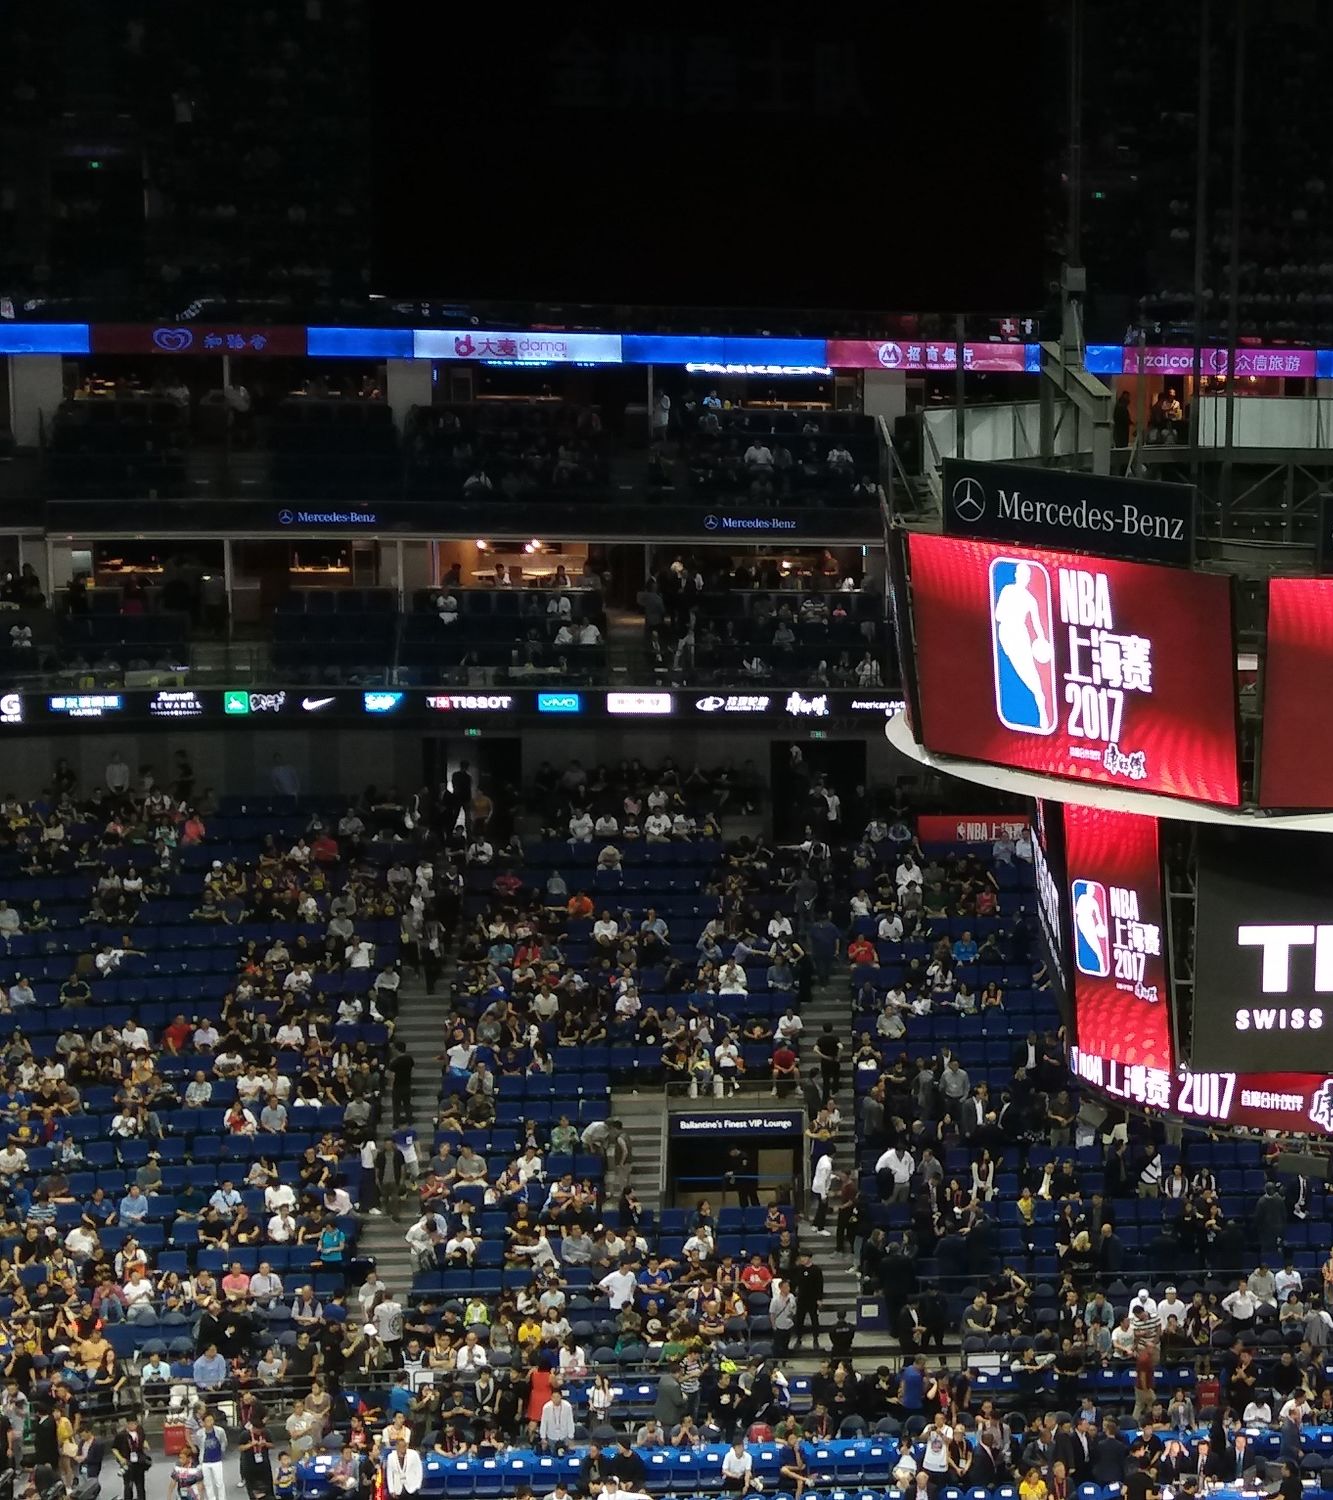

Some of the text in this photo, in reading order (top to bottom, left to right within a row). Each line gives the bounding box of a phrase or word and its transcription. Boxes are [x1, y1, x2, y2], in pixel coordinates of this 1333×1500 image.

[478, 338, 517, 356] 大麦
[1235, 354, 1301, 372] 众信旅游
[298, 511, 376, 523] Mercedes-Benz
[723, 517, 796, 529] Mercedes-Benz
[997, 489, 1185, 541] Mercedes-Benz
[1058, 568, 1113, 630] NBA
[1064, 625, 1152, 693] 上海赛
[150, 701, 202, 710] REWARDS
[450, 696, 511, 709] TISSOT
[852, 700, 888, 710] American
[1065, 686, 1124, 742] 2017
[966, 824, 988, 840] NBA
[1109, 886, 1140, 921] NBA
[1113, 919, 1160, 956] 上海赛
[1114, 948, 1146, 983] 2017
[1236, 1008, 1323, 1030] SWISS
[1105, 1059, 1171, 1109] 上海赛
[1177, 1072, 1237, 1119] 2017
[680, 1119, 792, 1130] Ballantine's Finest VIP Lounge
